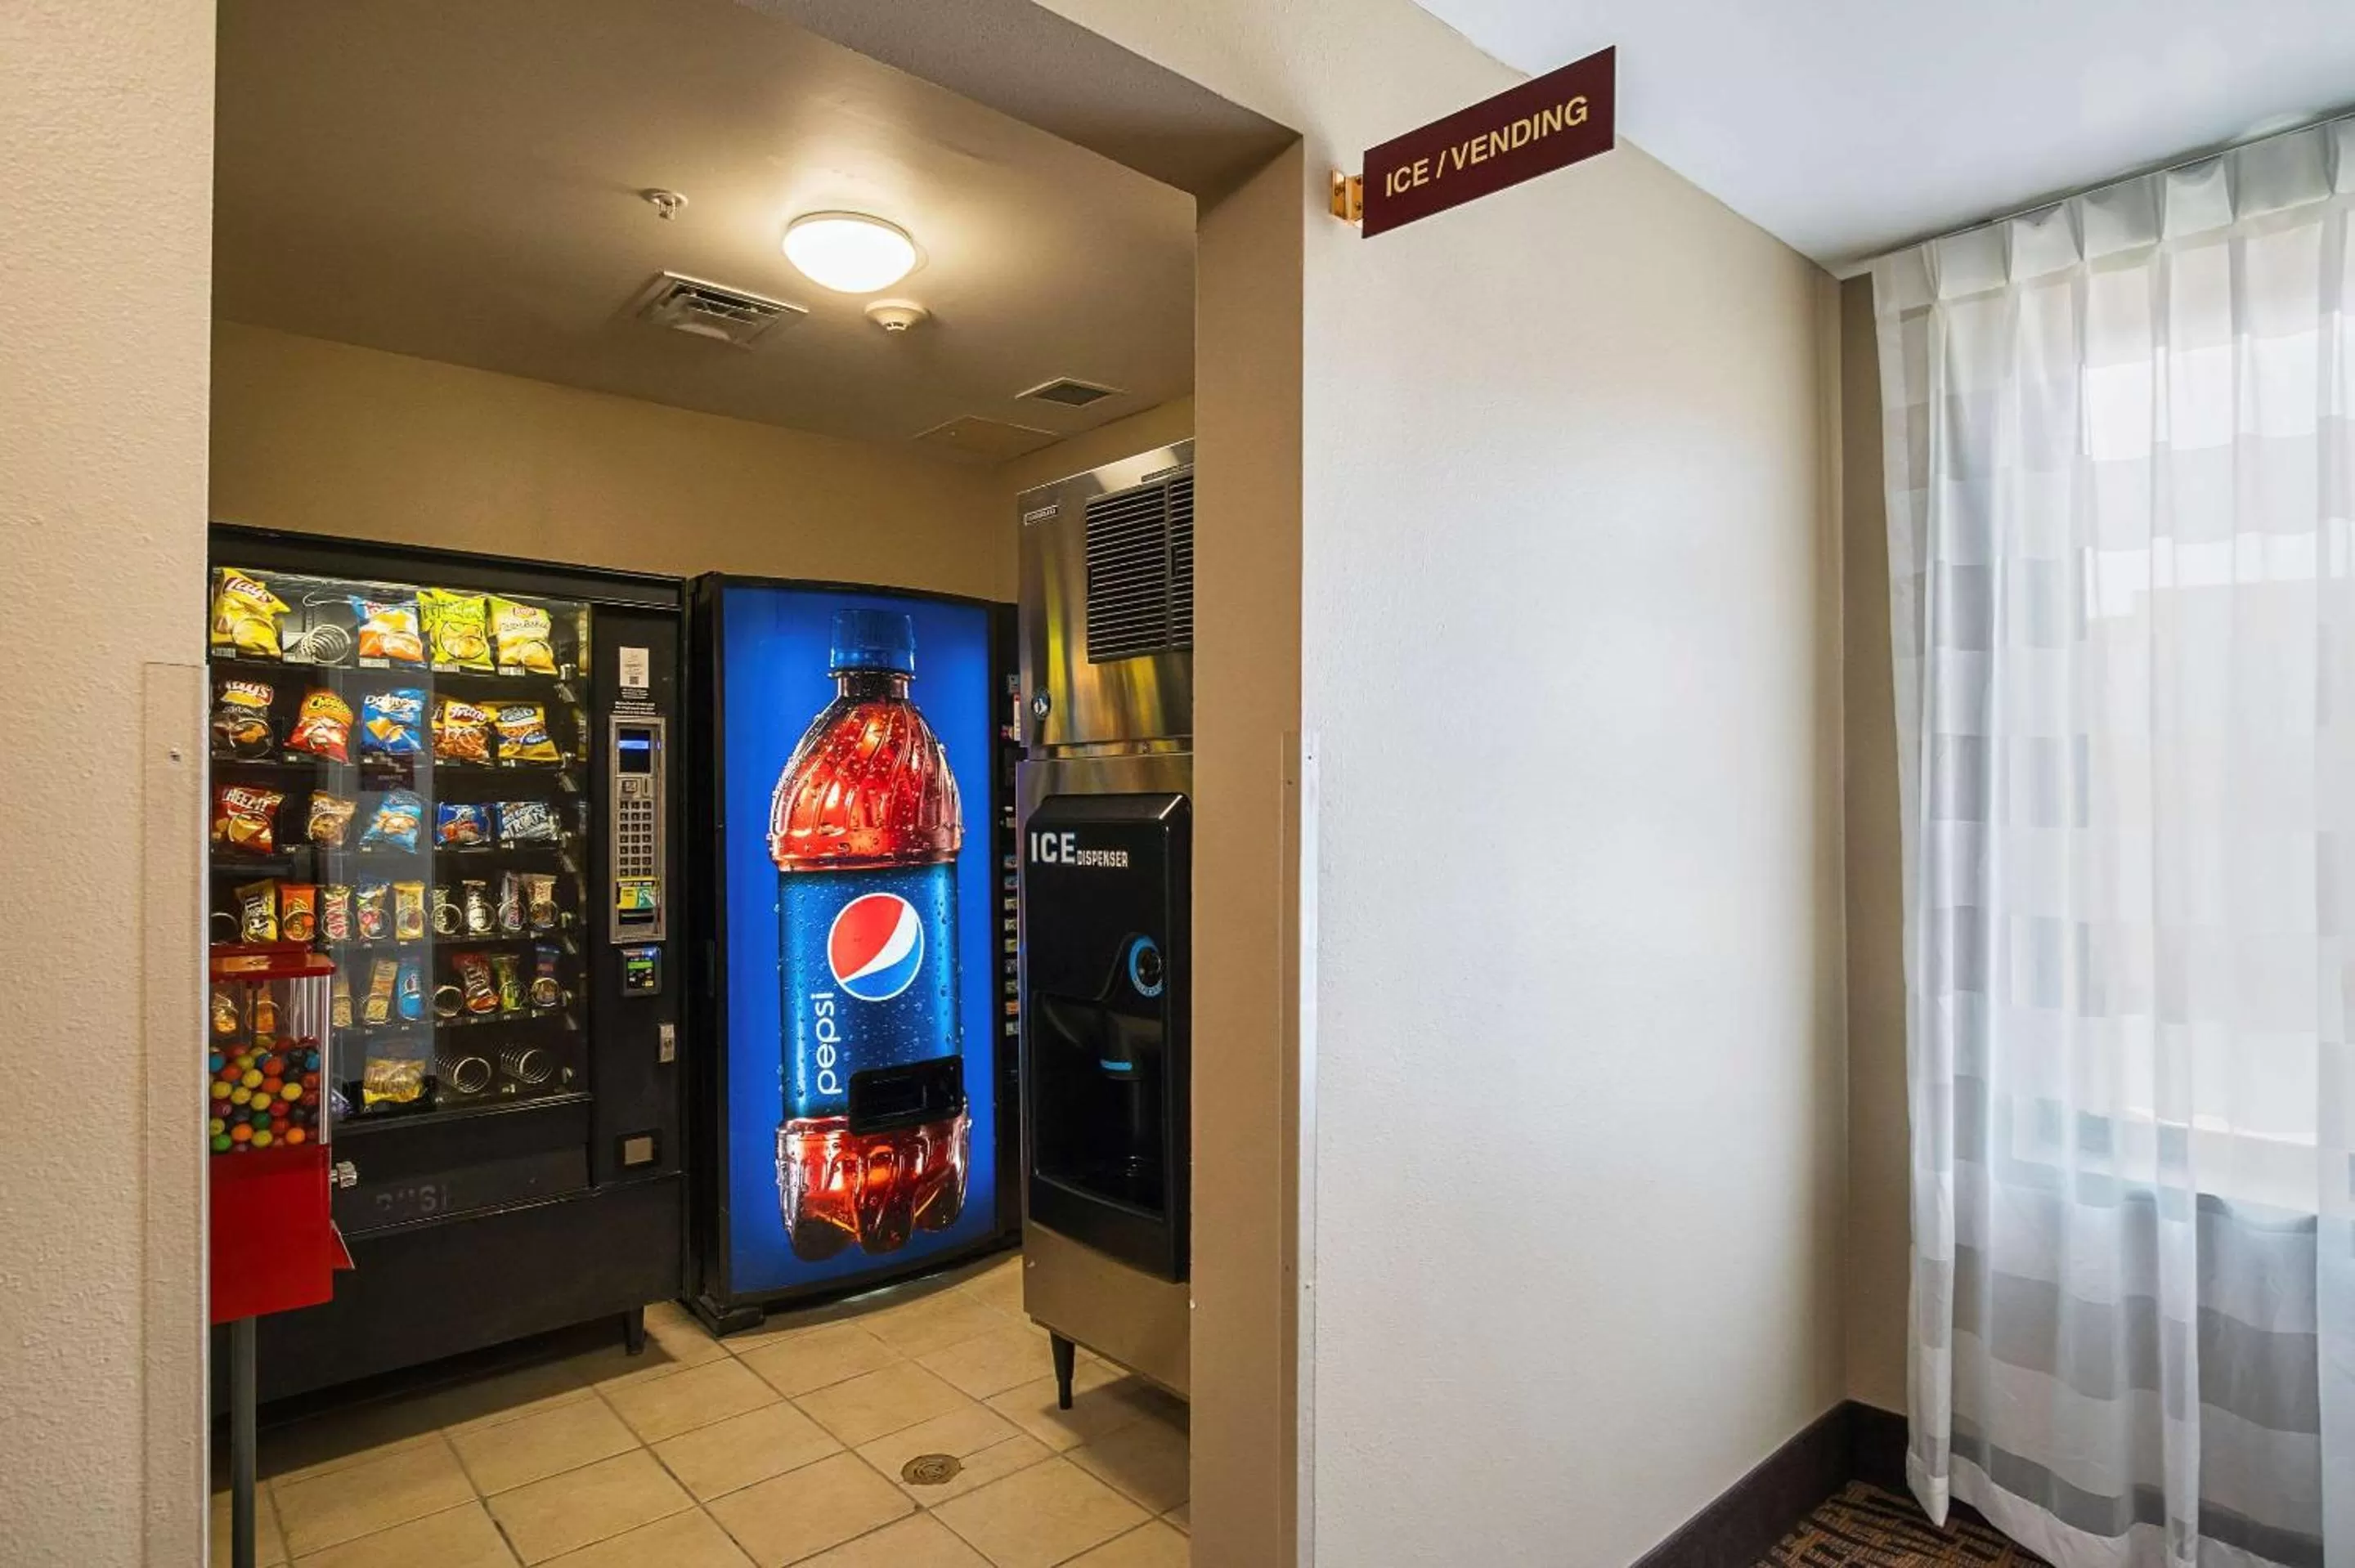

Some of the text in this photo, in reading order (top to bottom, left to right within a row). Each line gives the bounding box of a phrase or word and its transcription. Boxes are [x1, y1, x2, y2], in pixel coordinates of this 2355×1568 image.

[1385, 94, 1590, 198] ICE / VENDING
[1030, 831, 1128, 867] ICE DISPENSER
[810, 992, 842, 1095] pepsi
